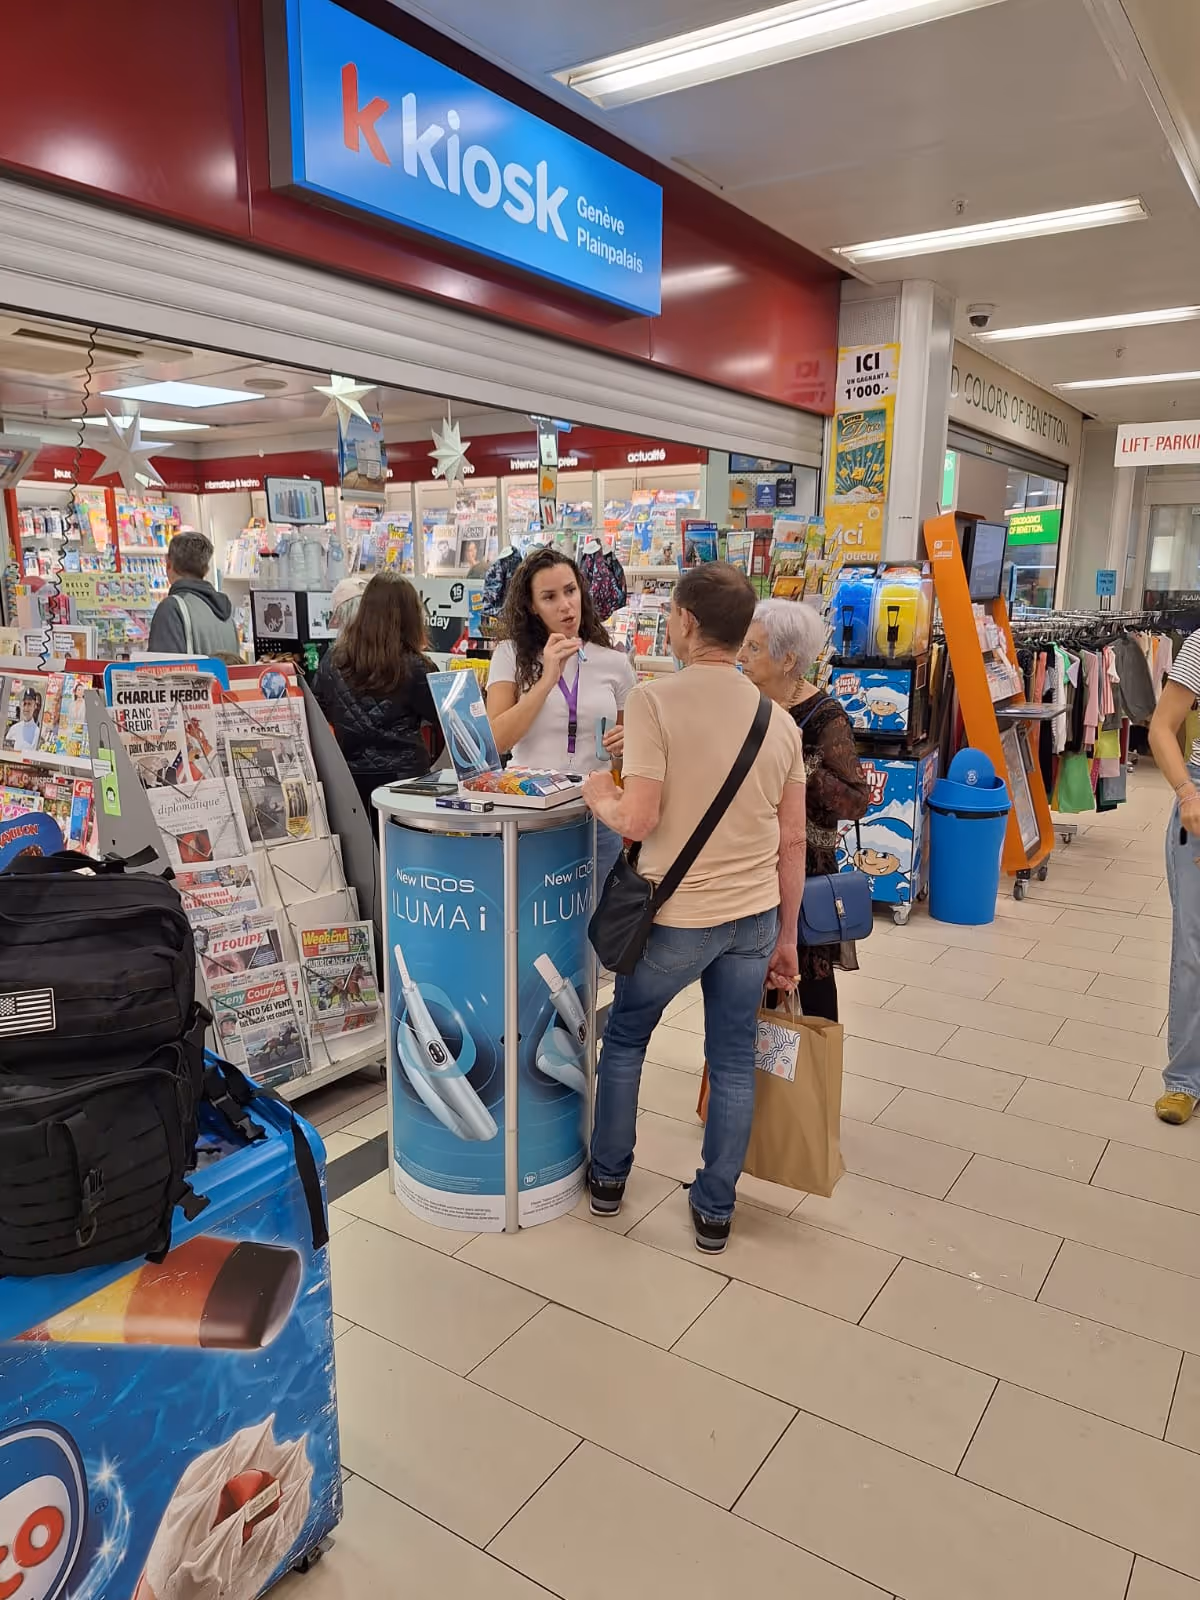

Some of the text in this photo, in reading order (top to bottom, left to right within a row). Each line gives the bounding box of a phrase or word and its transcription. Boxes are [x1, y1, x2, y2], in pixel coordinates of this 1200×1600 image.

[402, 93, 568, 242] kiosk
[577, 196, 624, 235] Genève
[577, 227, 643, 273] Plainpalais
[856, 352, 879, 373] ICI
[857, 373, 884, 383] GAGNANT
[845, 383, 888, 399] 1'000.-
[965, 373, 1008, 419] COLORS
[1011, 396, 1024, 426] OF
[510, 459, 538, 470] internat
[627, 449, 665, 463] actualité
[117, 689, 209, 705] CHARLIE HEBDO
[158, 799, 220, 816] diplomatique
[396, 867, 475, 893] New IQOS
[544, 857, 593, 887] New IQO
[192, 888, 230, 902] Journal
[392, 889, 486, 931] ILUMA i
[247, 984, 286, 999] Courses
[274, 998, 291, 1010] VENT
